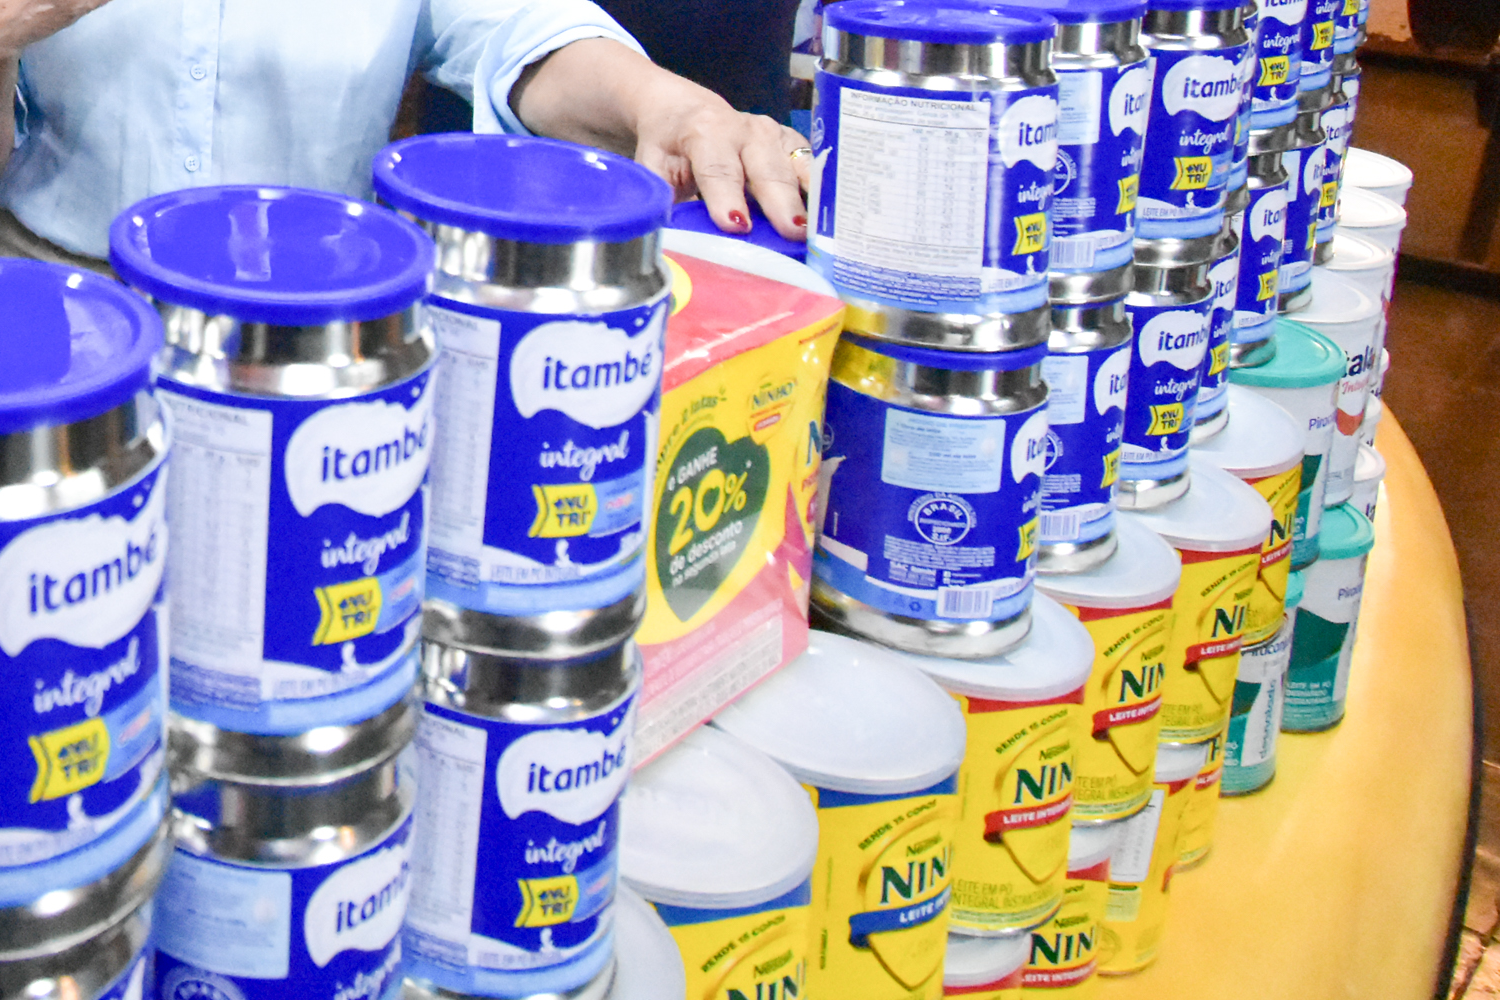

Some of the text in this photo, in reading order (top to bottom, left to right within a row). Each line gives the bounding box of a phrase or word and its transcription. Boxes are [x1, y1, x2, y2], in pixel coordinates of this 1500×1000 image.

[850, 91, 977, 112] INFORMAÇÃO NUTRICIONAL
[1178, 123, 1231, 155] integral
[542, 341, 653, 391] itambé
[539, 429, 630, 481] integral
[677, 445, 719, 485] GANHE
[668, 468, 748, 556] 20%
[320, 510, 410, 576] integral
[669, 519, 743, 576] de desconto
[1102, 632, 1132, 658] RENDE
[1201, 642, 1225, 656] LEITE
[34, 635, 141, 719] integral
[1108, 709, 1137, 723] LEITE
[995, 728, 1029, 755] RENDE
[526, 744, 627, 795] itambé
[1002, 810, 1037, 825] LEITE
[524, 820, 607, 875] integral
[857, 822, 894, 851] RENDE
[877, 846, 950, 907] NIN
[898, 902, 935, 924] LEITE
[700, 940, 738, 974] RENDE
[1028, 924, 1096, 967] NIN
[1022, 973, 1051, 983] EITE
